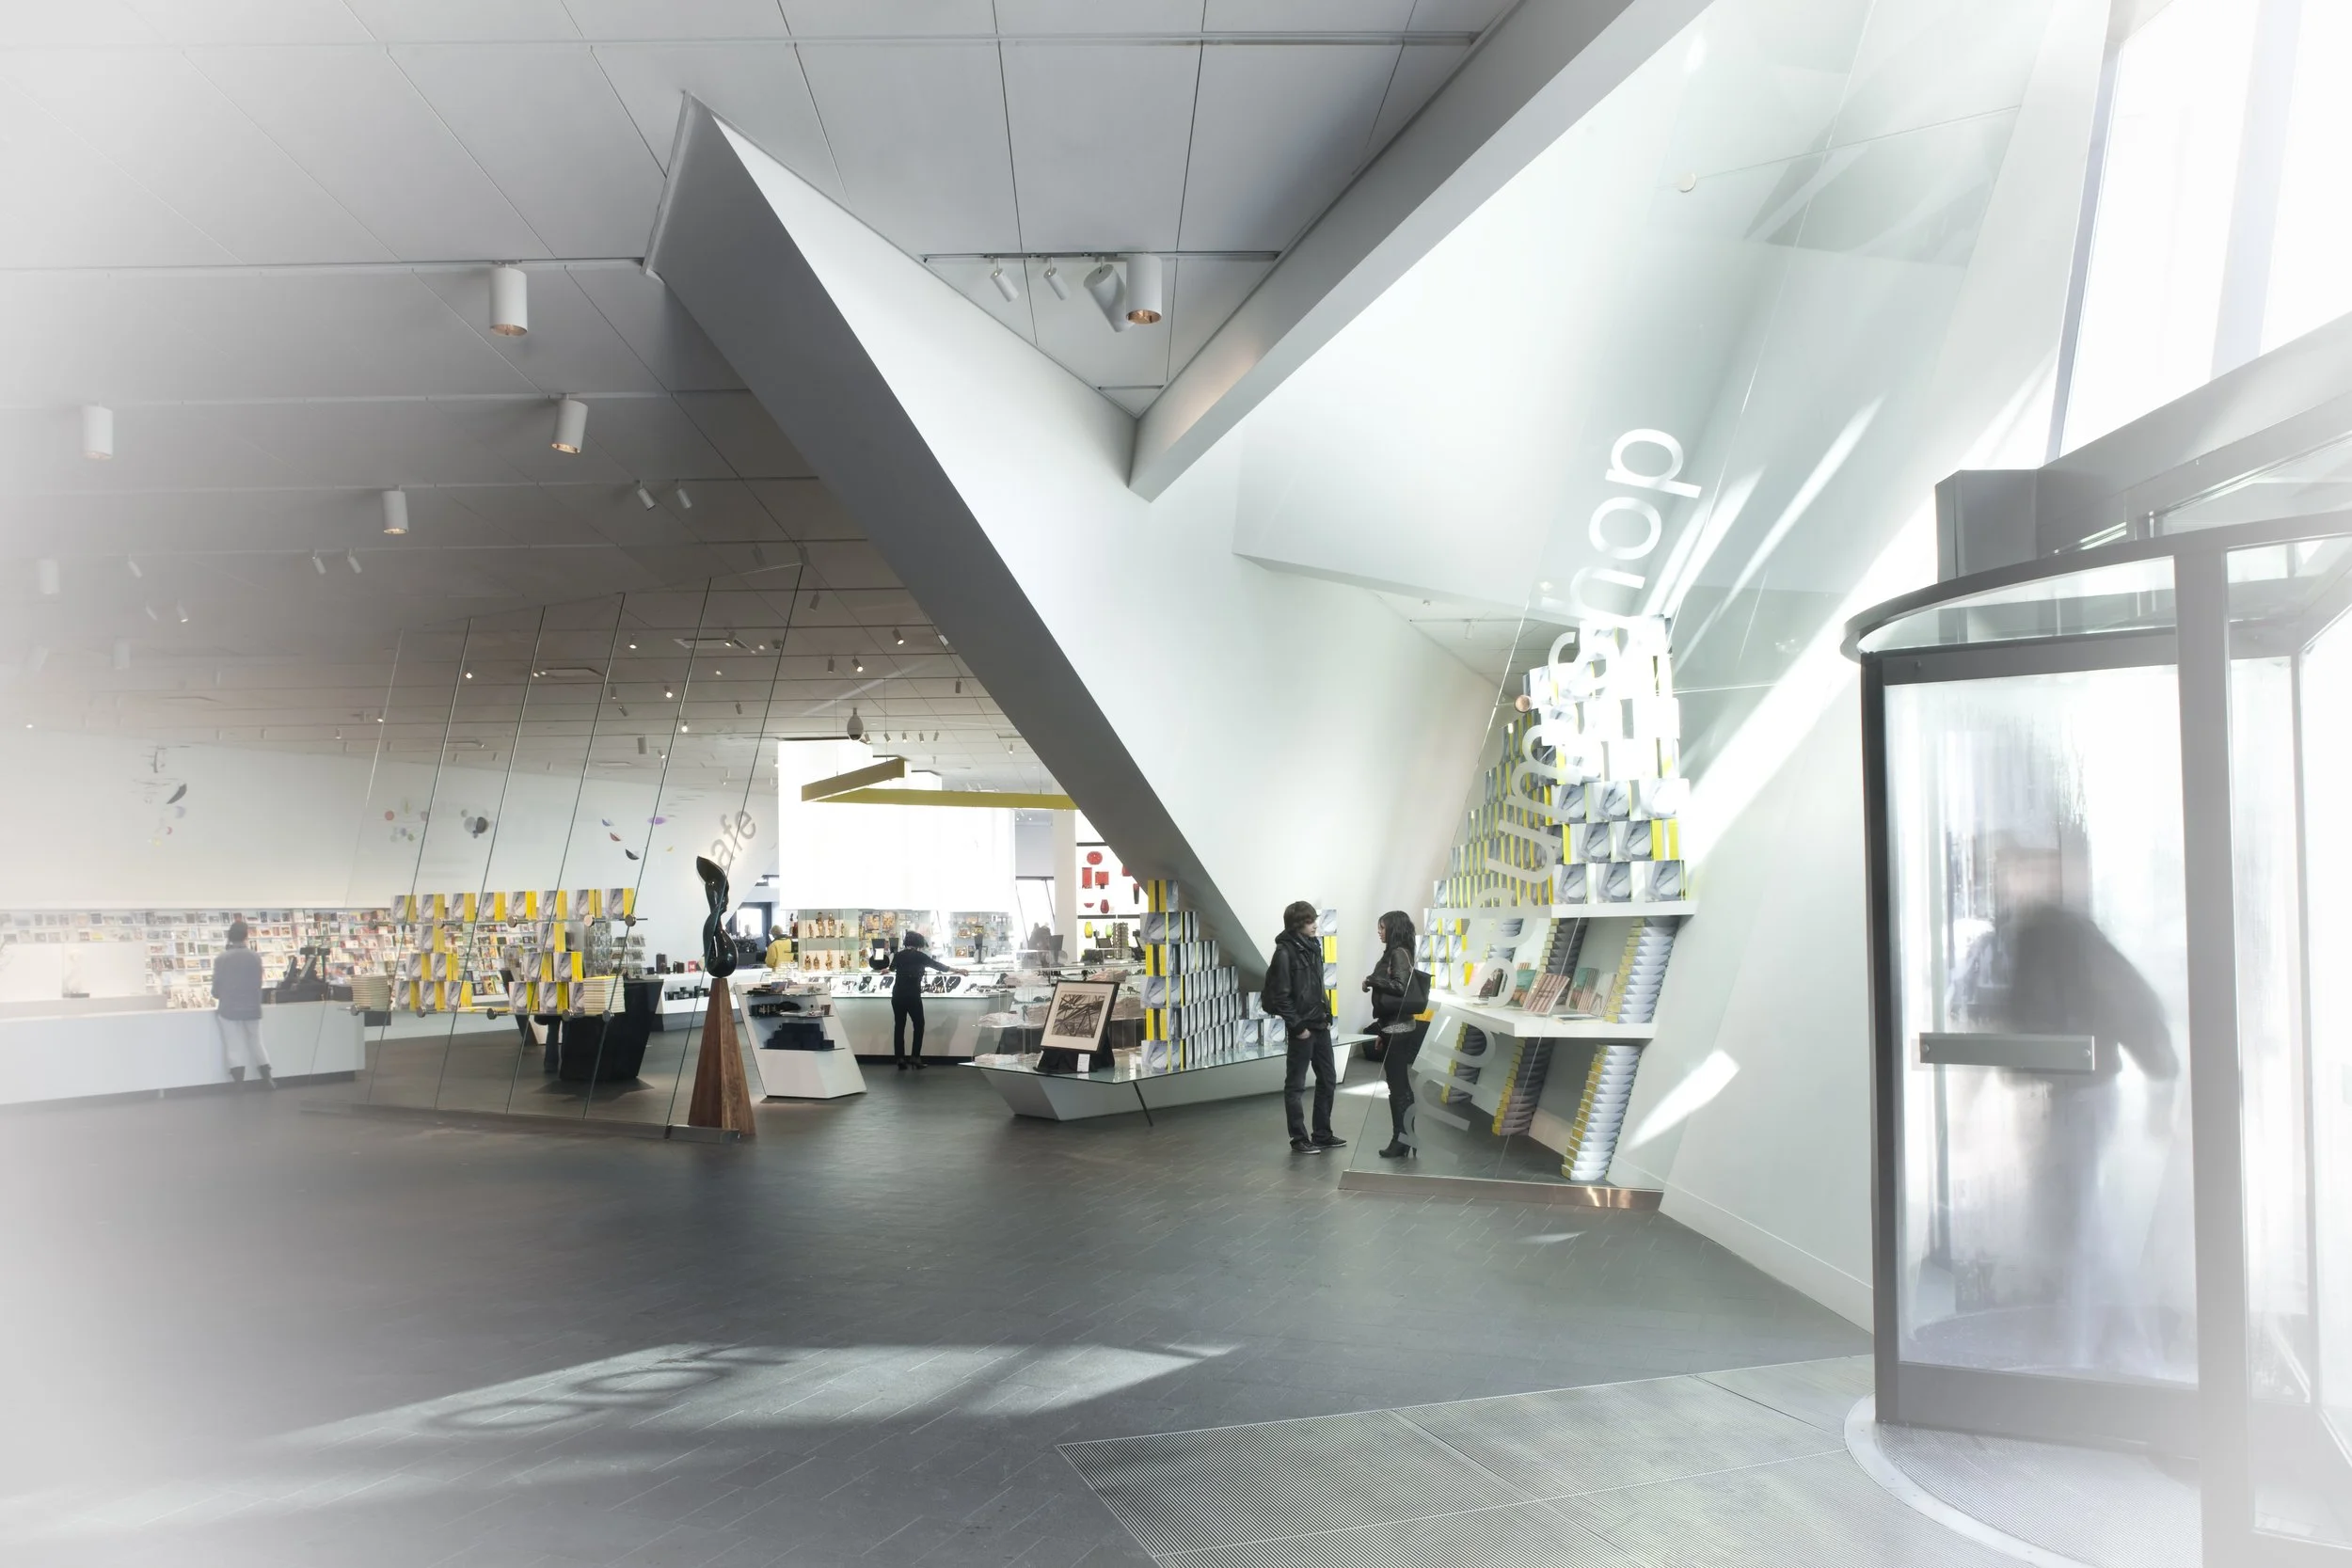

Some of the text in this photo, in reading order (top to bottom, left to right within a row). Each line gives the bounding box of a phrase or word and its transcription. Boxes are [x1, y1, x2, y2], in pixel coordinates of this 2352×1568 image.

[710, 810, 756, 871] afe
[1397, 428, 1702, 1165] museum shop
